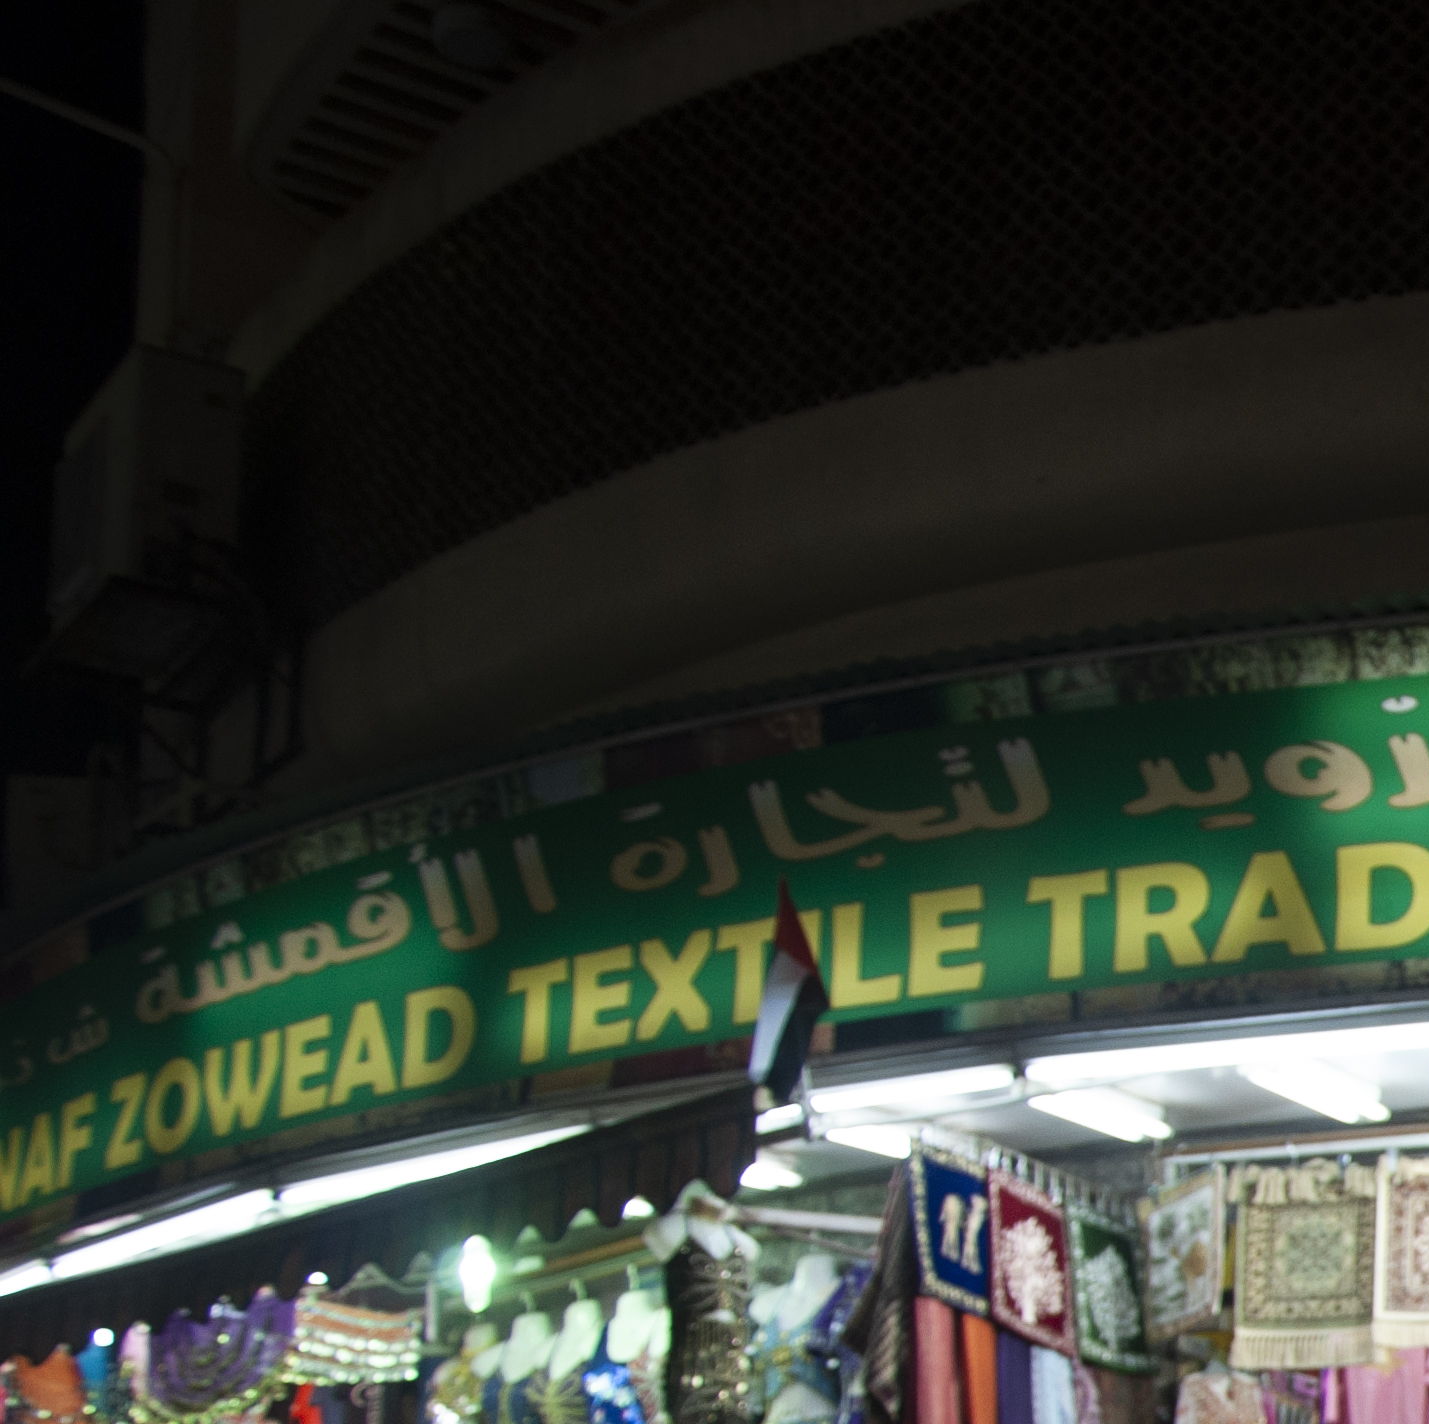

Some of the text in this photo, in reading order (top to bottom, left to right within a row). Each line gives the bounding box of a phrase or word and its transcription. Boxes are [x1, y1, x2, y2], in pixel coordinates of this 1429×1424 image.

[609, 737, 1052, 897] لتجارة
[102, 982, 478, 1172] ZOWEAD
[506, 883, 985, 1065] TEXTLE
